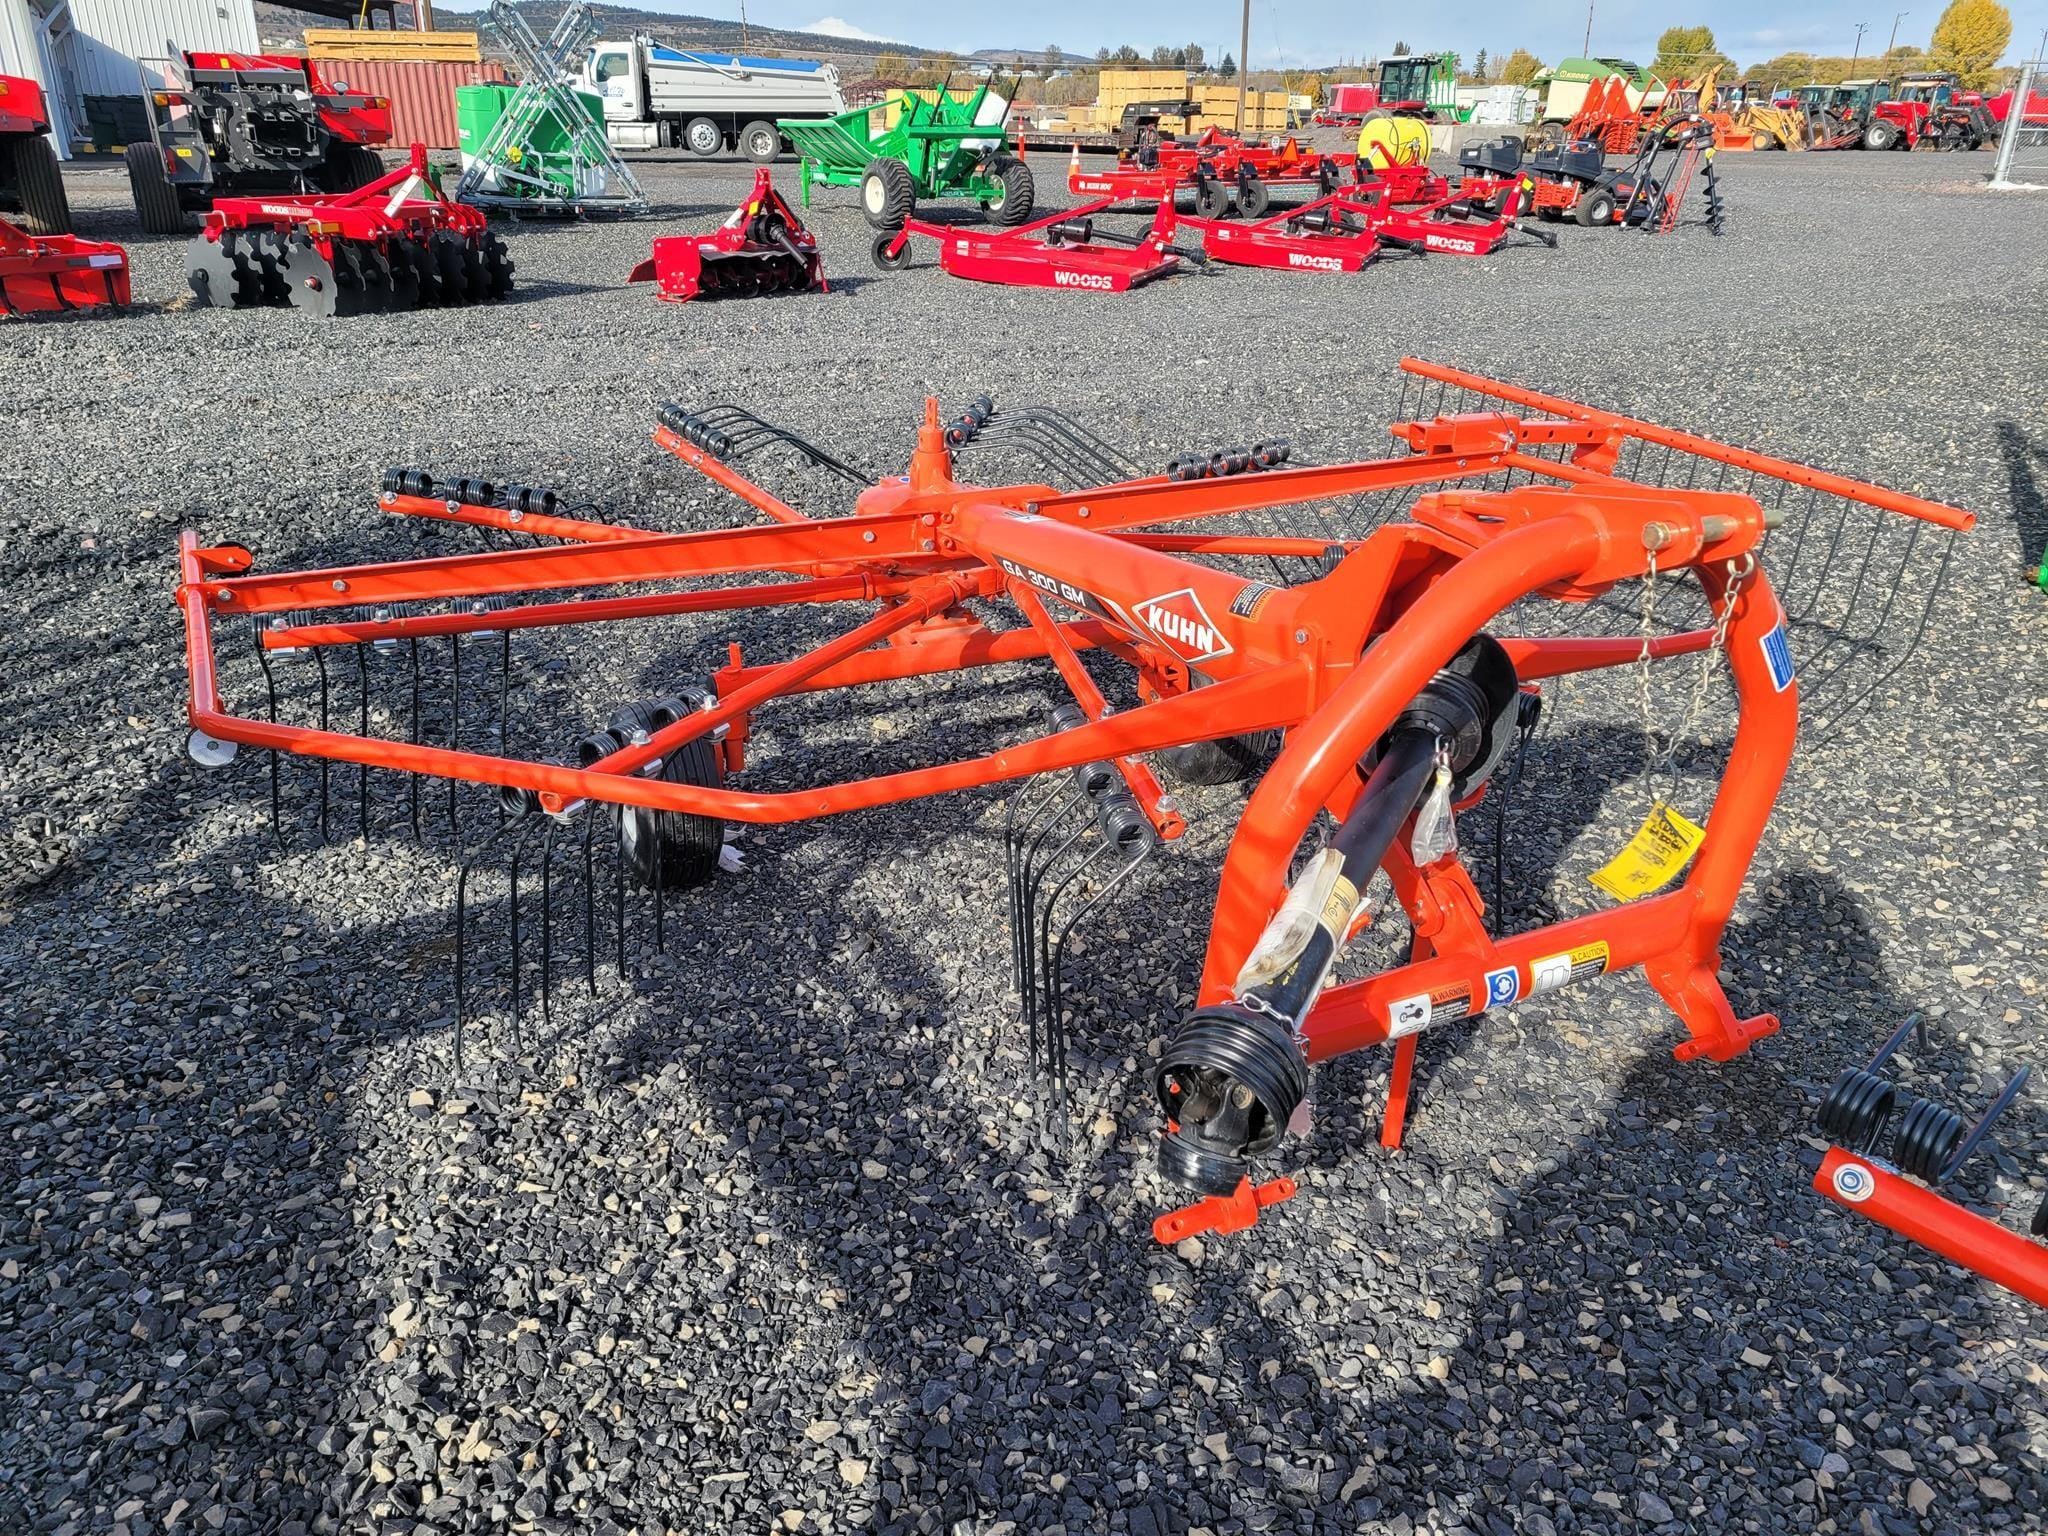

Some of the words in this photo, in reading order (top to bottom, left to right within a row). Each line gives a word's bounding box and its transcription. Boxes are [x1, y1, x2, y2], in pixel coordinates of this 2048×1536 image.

[1426, 234, 1475, 253] WOODS
[1289, 253, 1343, 271] WOODS
[1054, 271, 1113, 290] WOODS
[1002, 559, 1027, 580] GA
[1028, 569, 1058, 595] 300
[1061, 583, 1086, 607] GM
[1148, 603, 1214, 655] KUHN
[1578, 946, 1605, 961] CAUTION
[1440, 984, 1469, 1001] WARNING
